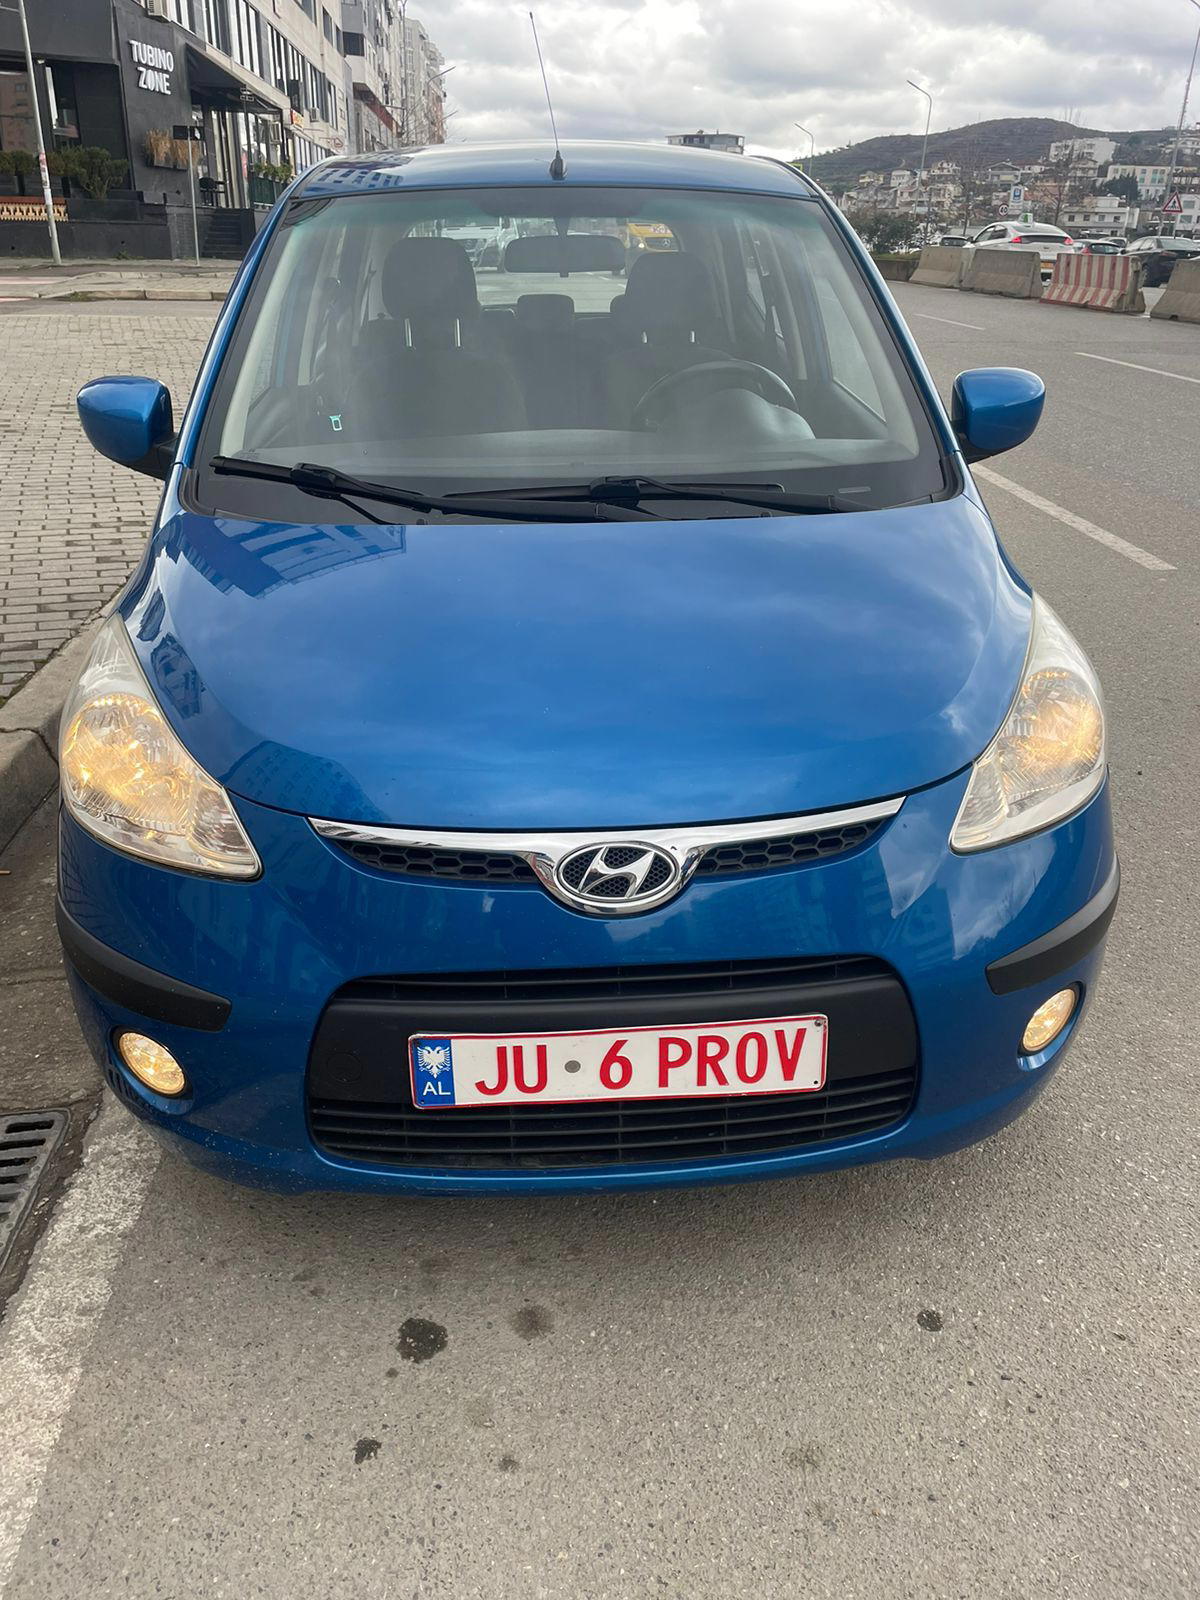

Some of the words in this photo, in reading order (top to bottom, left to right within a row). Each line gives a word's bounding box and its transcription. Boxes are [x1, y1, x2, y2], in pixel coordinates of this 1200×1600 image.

[129, 40, 174, 72] TUBINO
[137, 66, 171, 95] ZONE
[475, 1044, 548, 1096] JU
[599, 1039, 633, 1090] 6
[658, 1027, 808, 1089] PROV
[422, 1081, 452, 1096] AL
